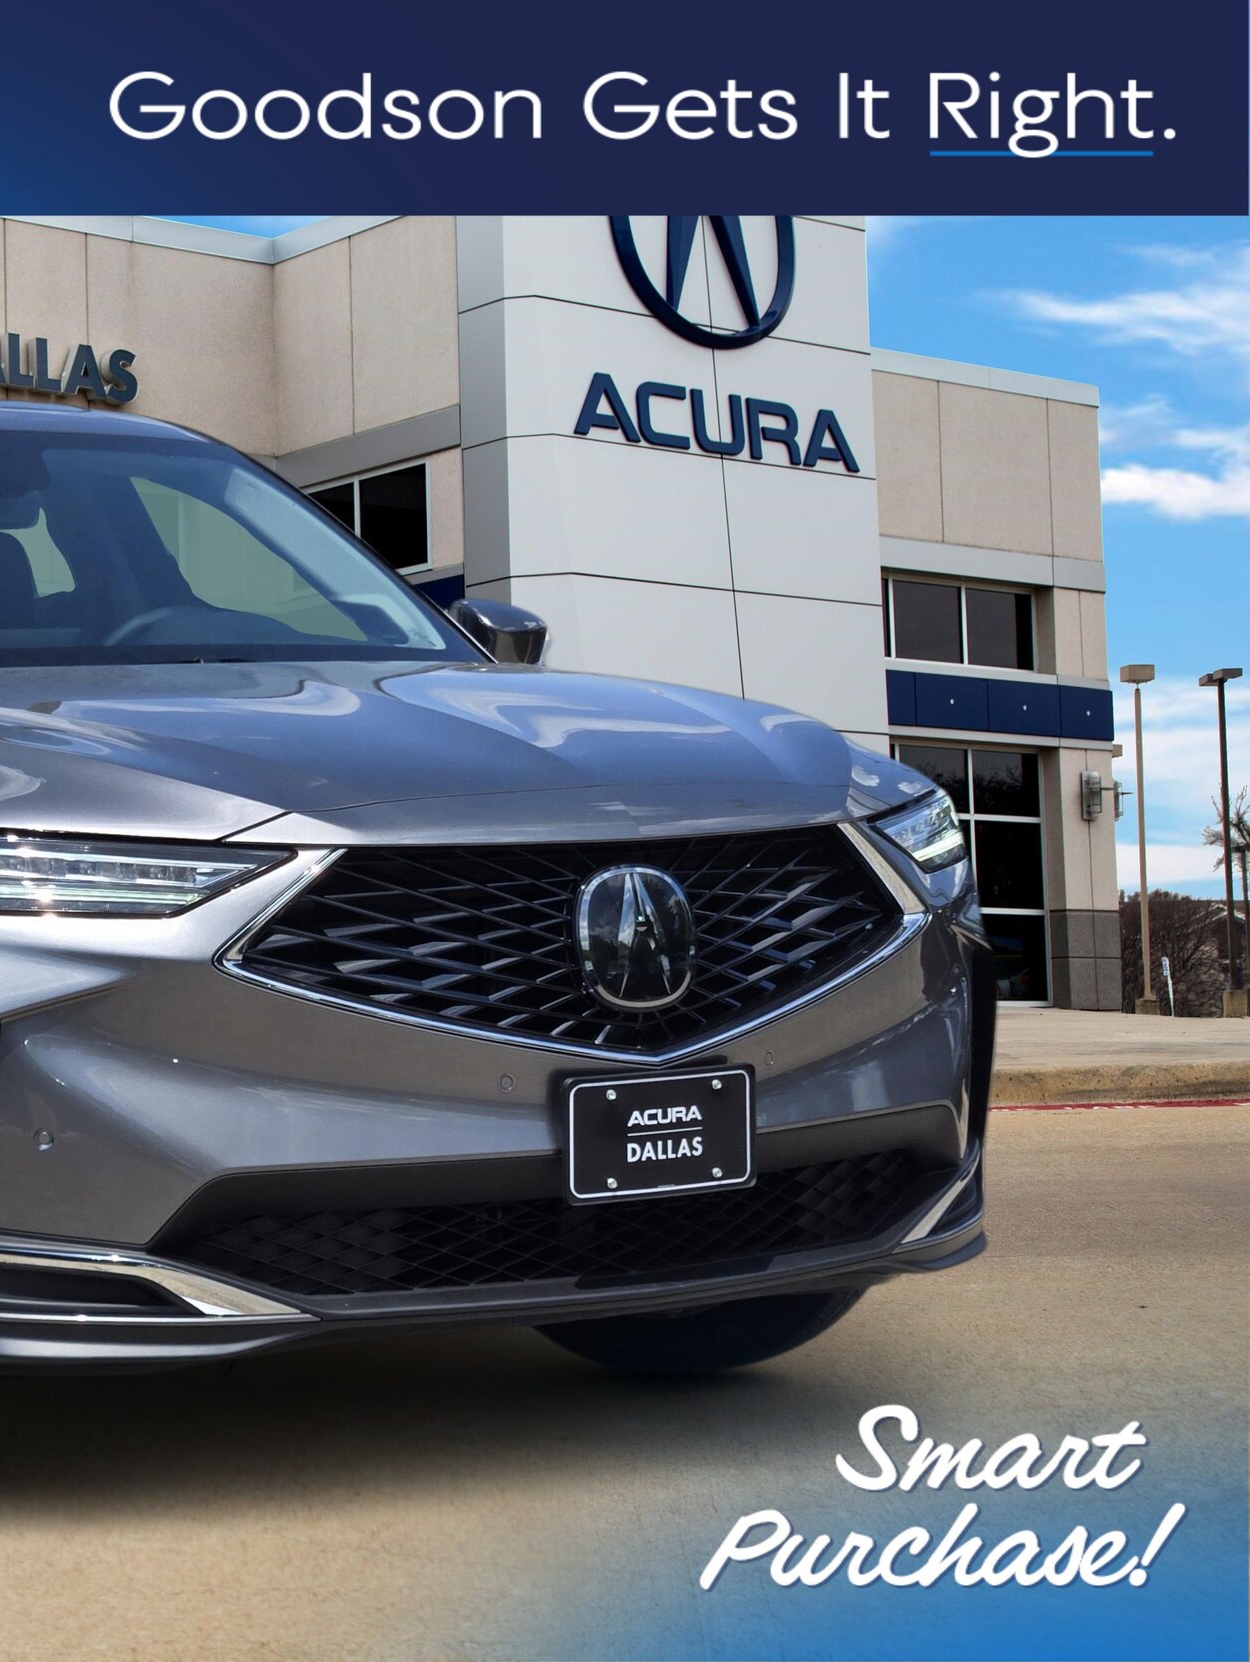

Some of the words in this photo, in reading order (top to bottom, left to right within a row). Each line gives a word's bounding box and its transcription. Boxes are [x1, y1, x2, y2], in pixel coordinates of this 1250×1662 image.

[574, 372, 860, 474] ACURA
[627, 1105, 702, 1127] ACURA
[627, 1136, 703, 1162] DALLAS
